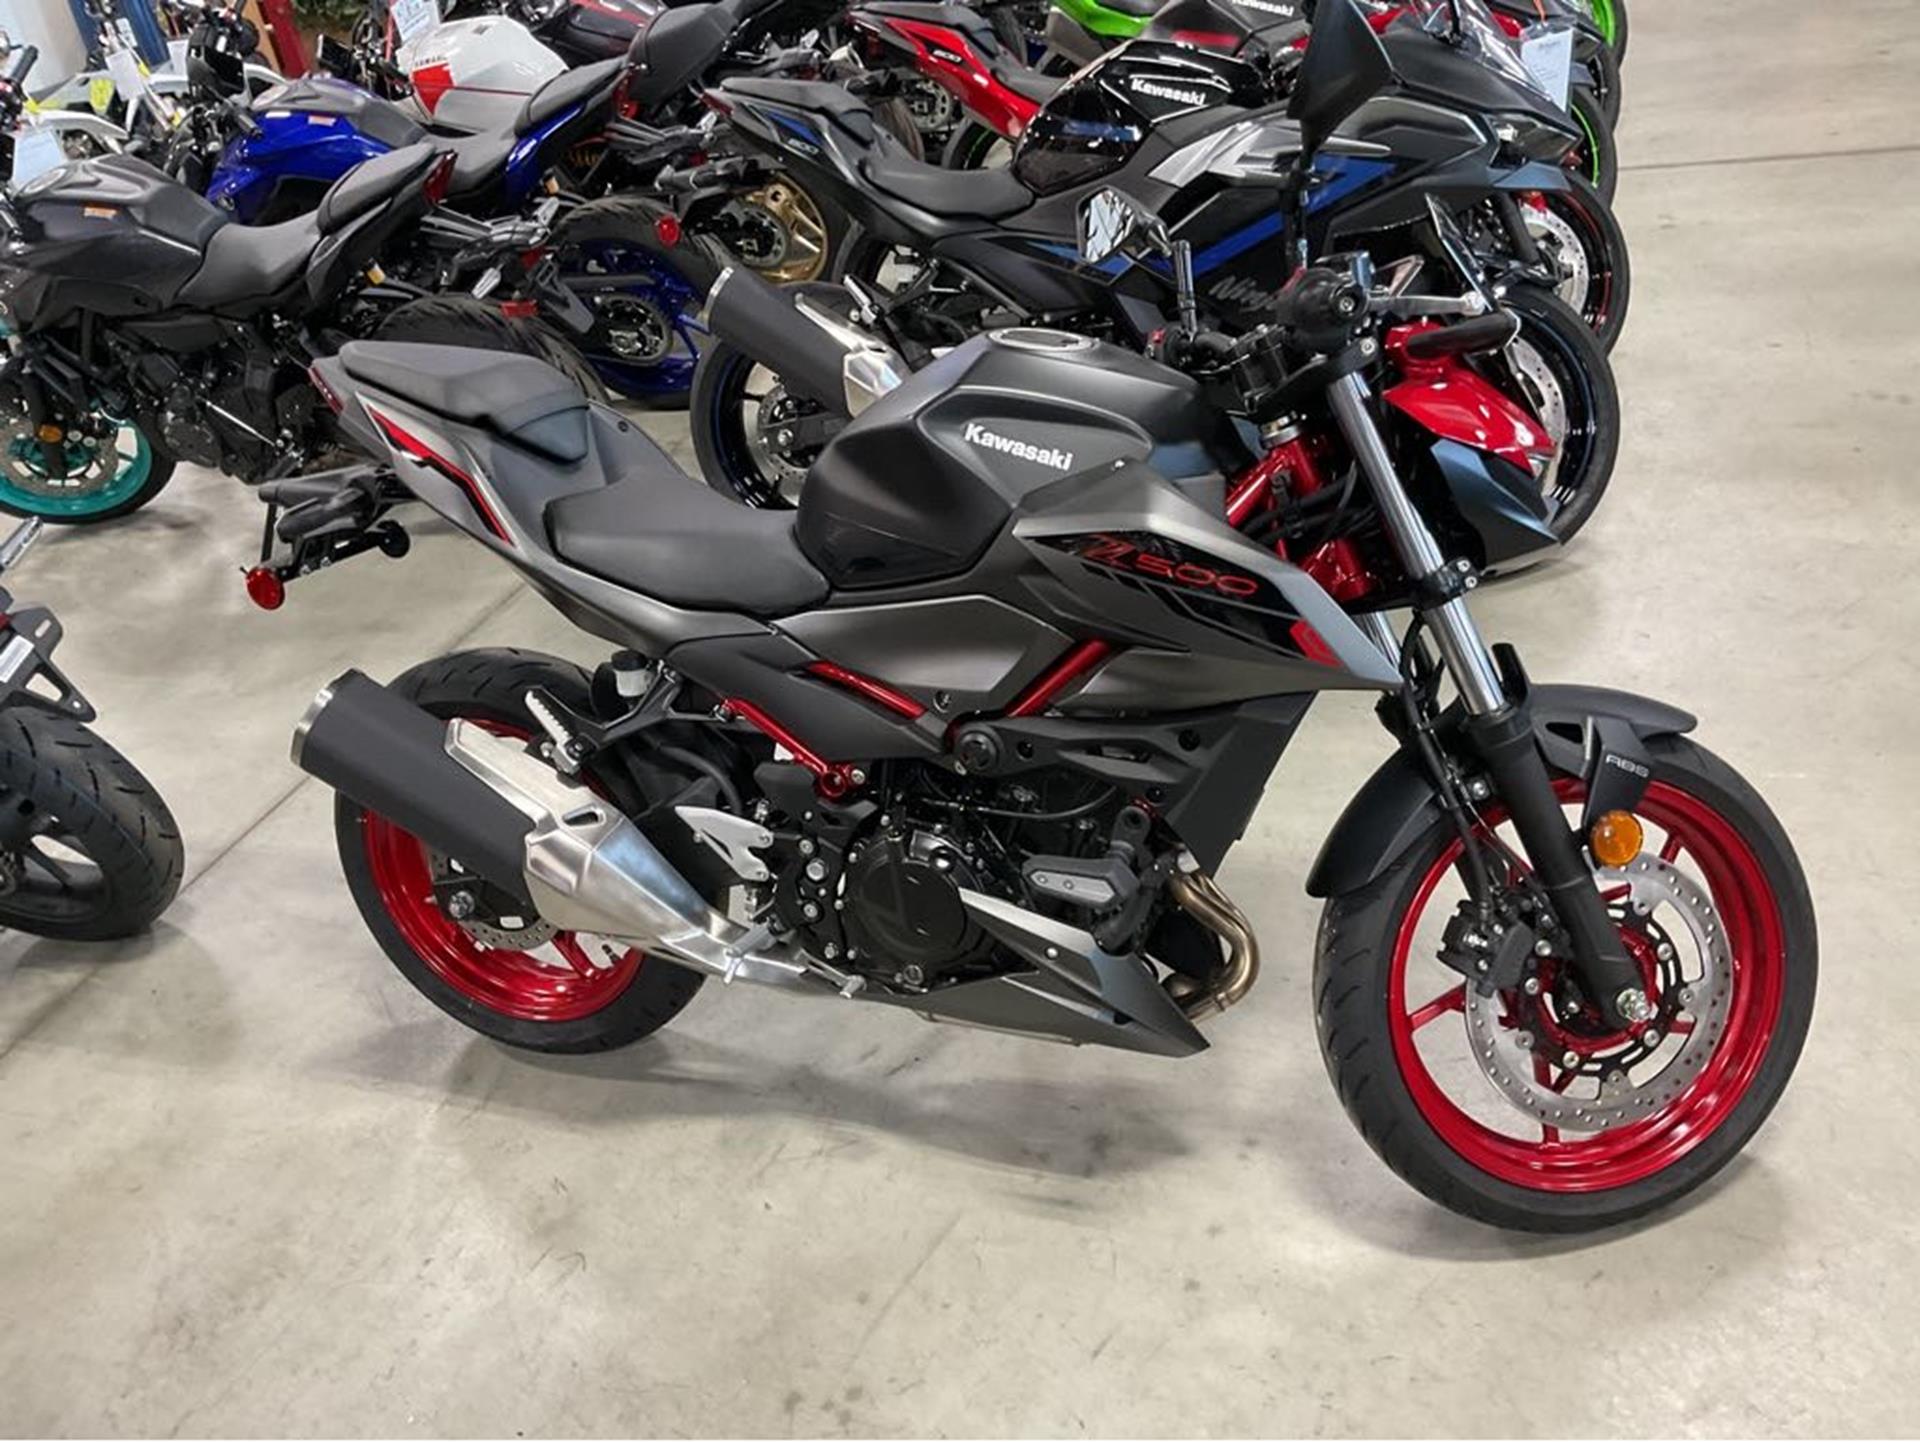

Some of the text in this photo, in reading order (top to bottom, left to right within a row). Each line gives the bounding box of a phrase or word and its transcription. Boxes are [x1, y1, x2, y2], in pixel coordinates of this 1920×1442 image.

[1131, 78, 1206, 106] Kawasaki
[964, 422, 1073, 471] Kawasaki
[1080, 534, 1259, 597] Z500
[1605, 753, 1650, 779] ABS
